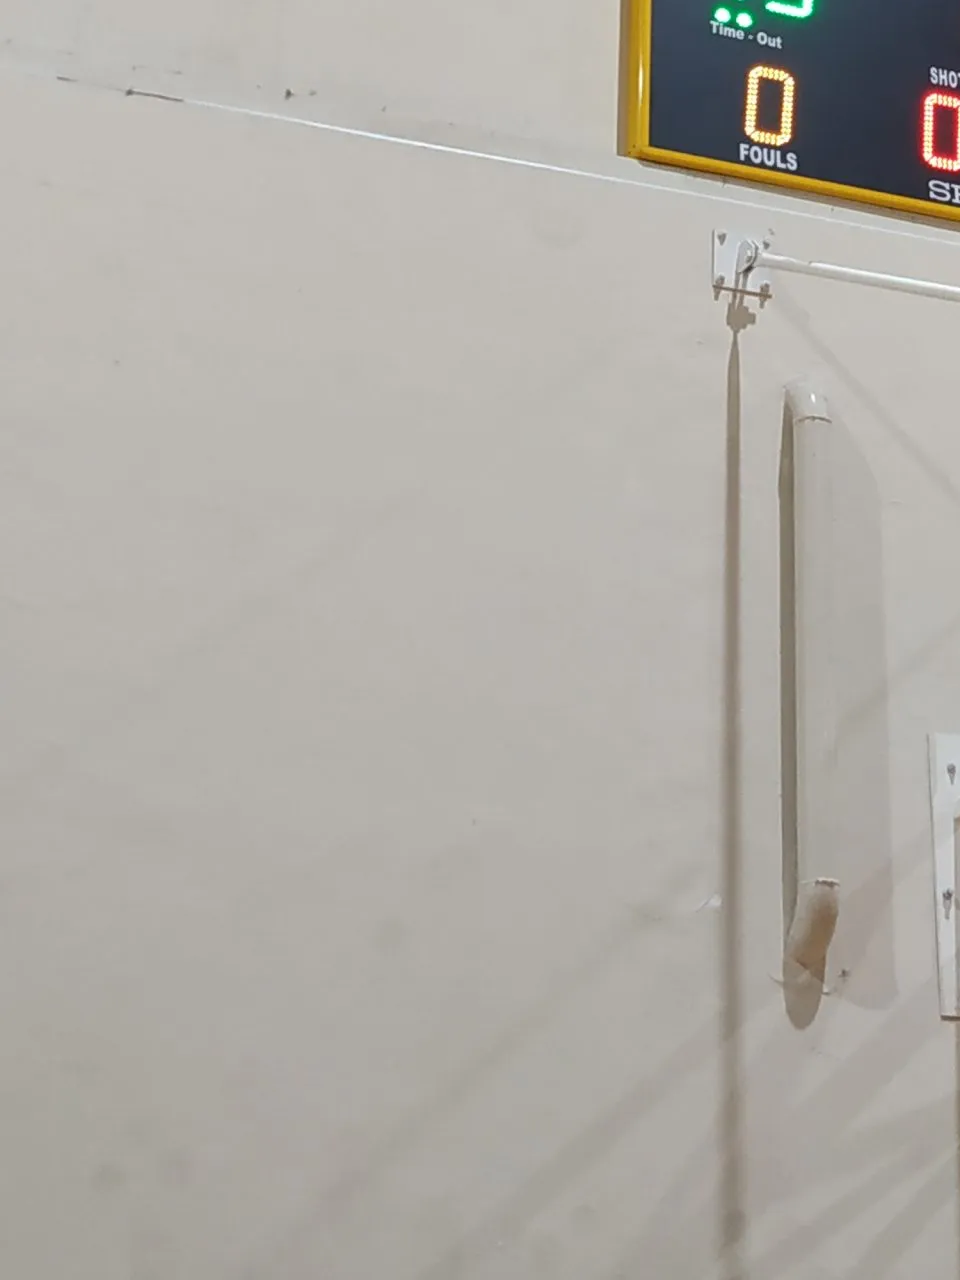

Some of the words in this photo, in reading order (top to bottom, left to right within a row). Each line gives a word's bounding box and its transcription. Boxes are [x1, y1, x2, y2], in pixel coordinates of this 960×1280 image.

[709, 20, 745, 40] Time
[756, 31, 783, 49] Out
[743, 65, 796, 147] 0
[739, 143, 798, 173] FOULS
